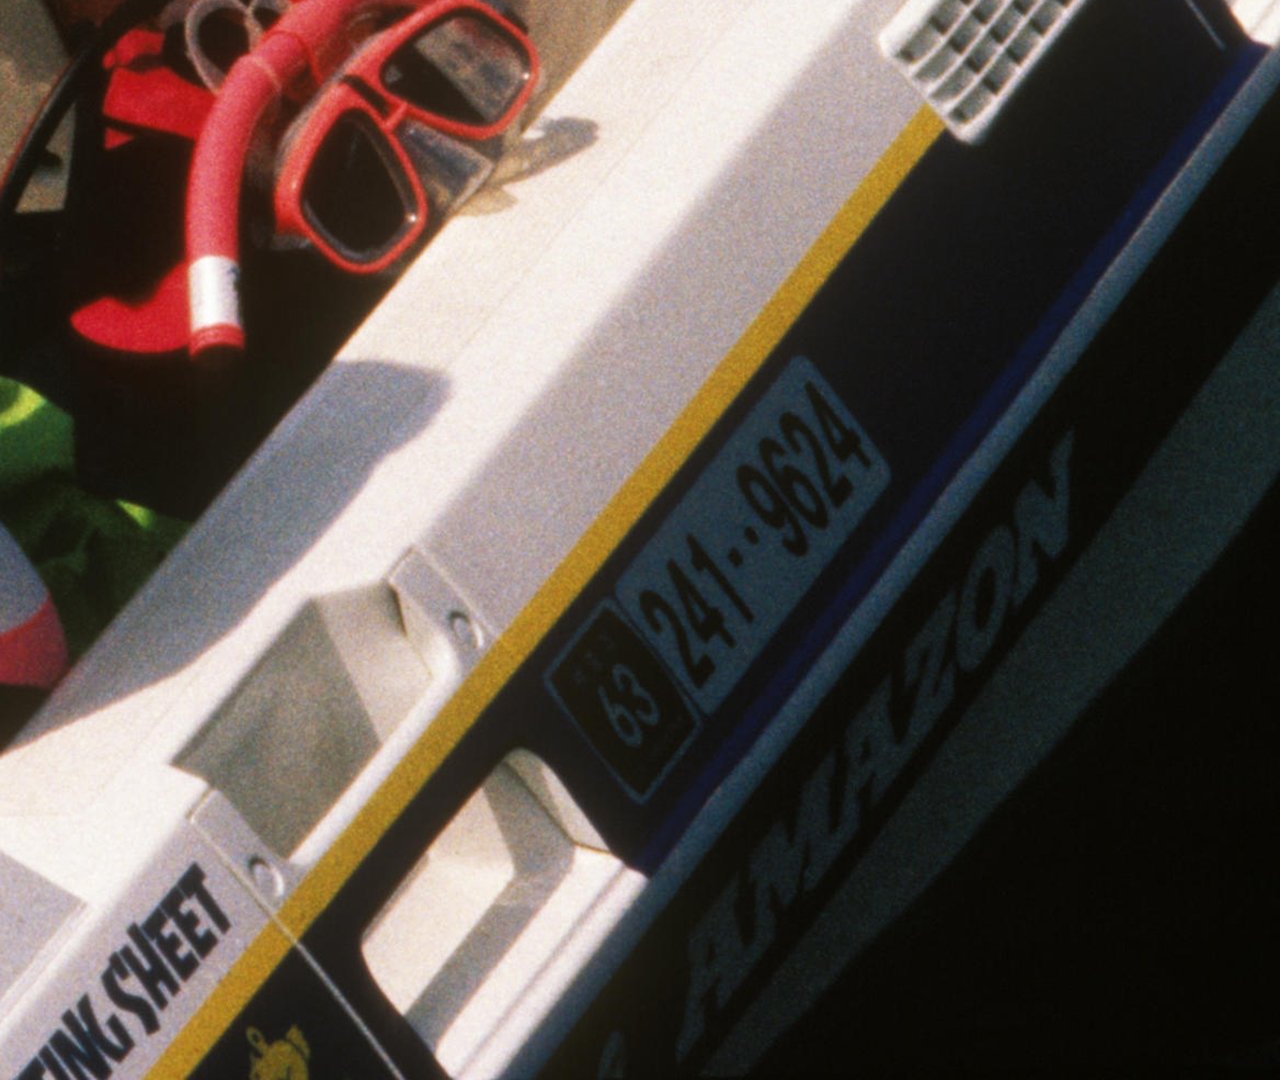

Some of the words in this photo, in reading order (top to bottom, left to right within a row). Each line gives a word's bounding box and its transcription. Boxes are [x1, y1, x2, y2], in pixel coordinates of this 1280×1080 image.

[598, 664, 660, 747] 63
[675, 428, 1074, 1063] AMAZON
[102, 862, 231, 1035] SHEET
